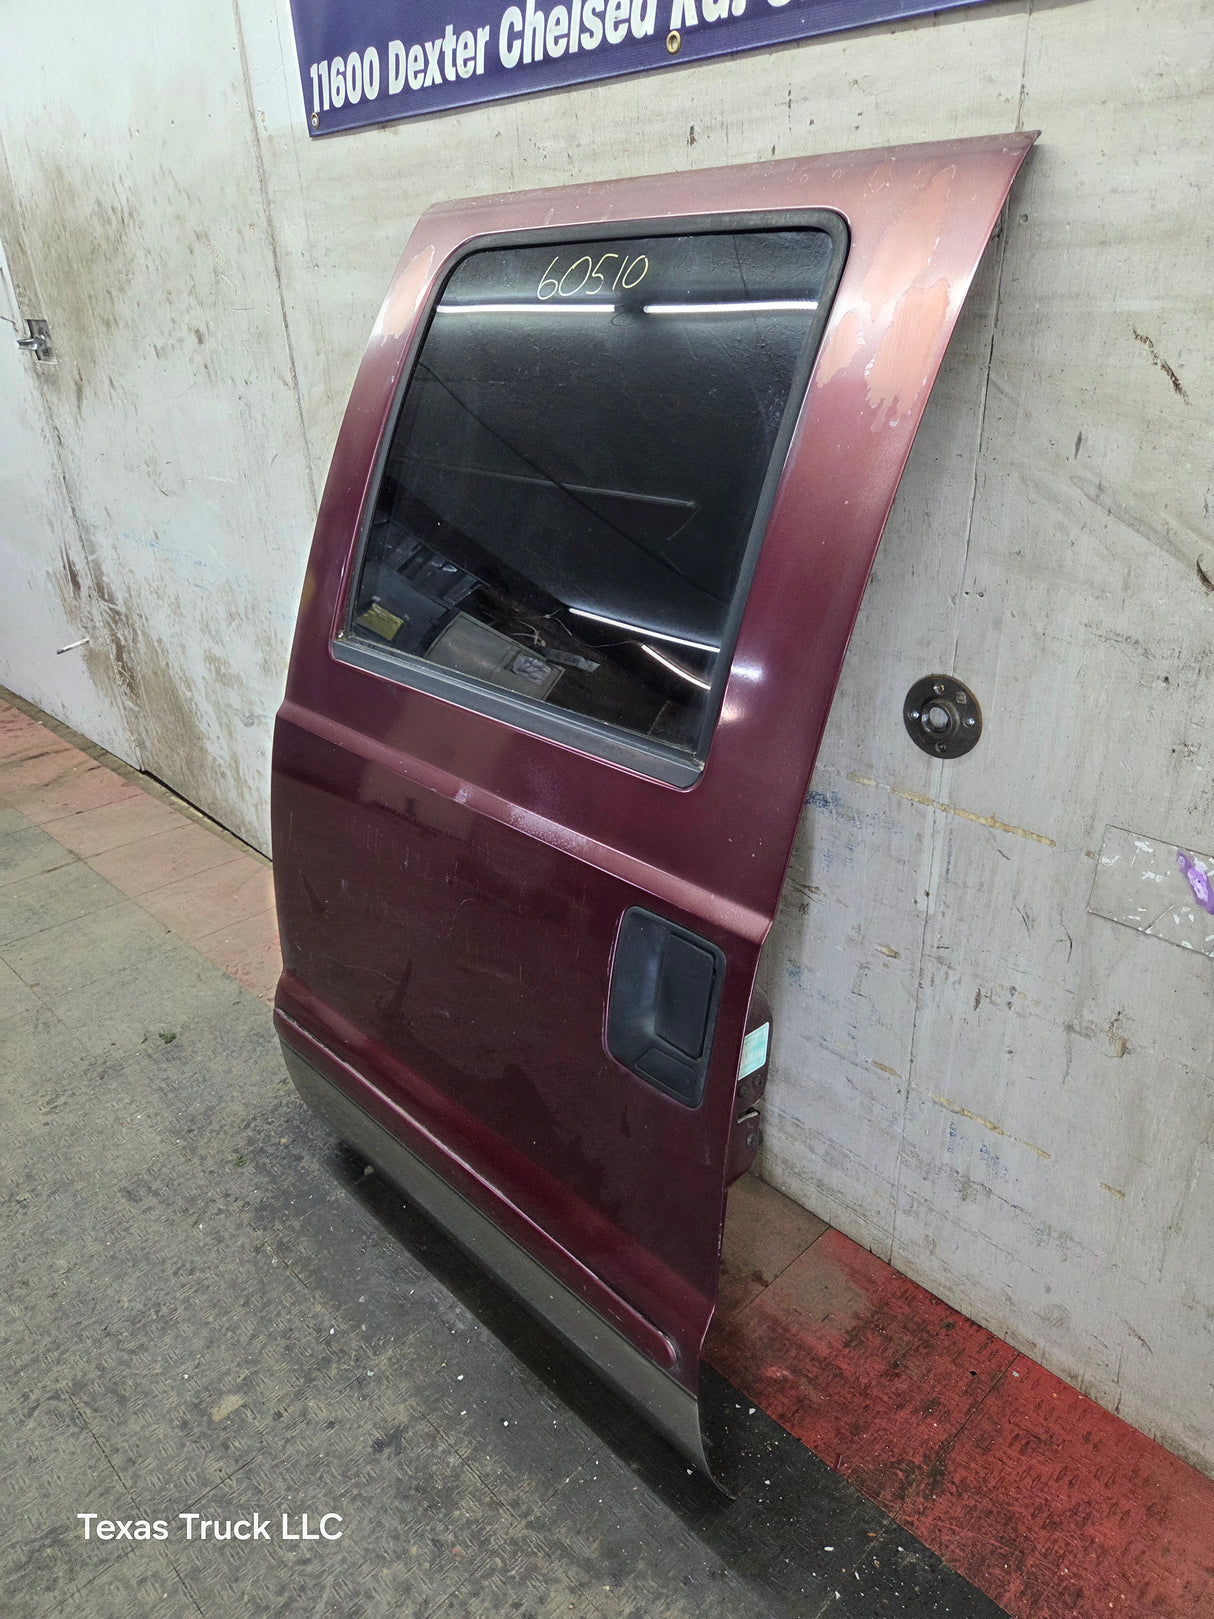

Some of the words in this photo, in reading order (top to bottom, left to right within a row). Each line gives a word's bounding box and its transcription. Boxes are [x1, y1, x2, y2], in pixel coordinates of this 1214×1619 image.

[310, 46, 380, 113] 11600
[388, 24, 490, 95] Dexter
[537, 253, 649, 300] 60510
